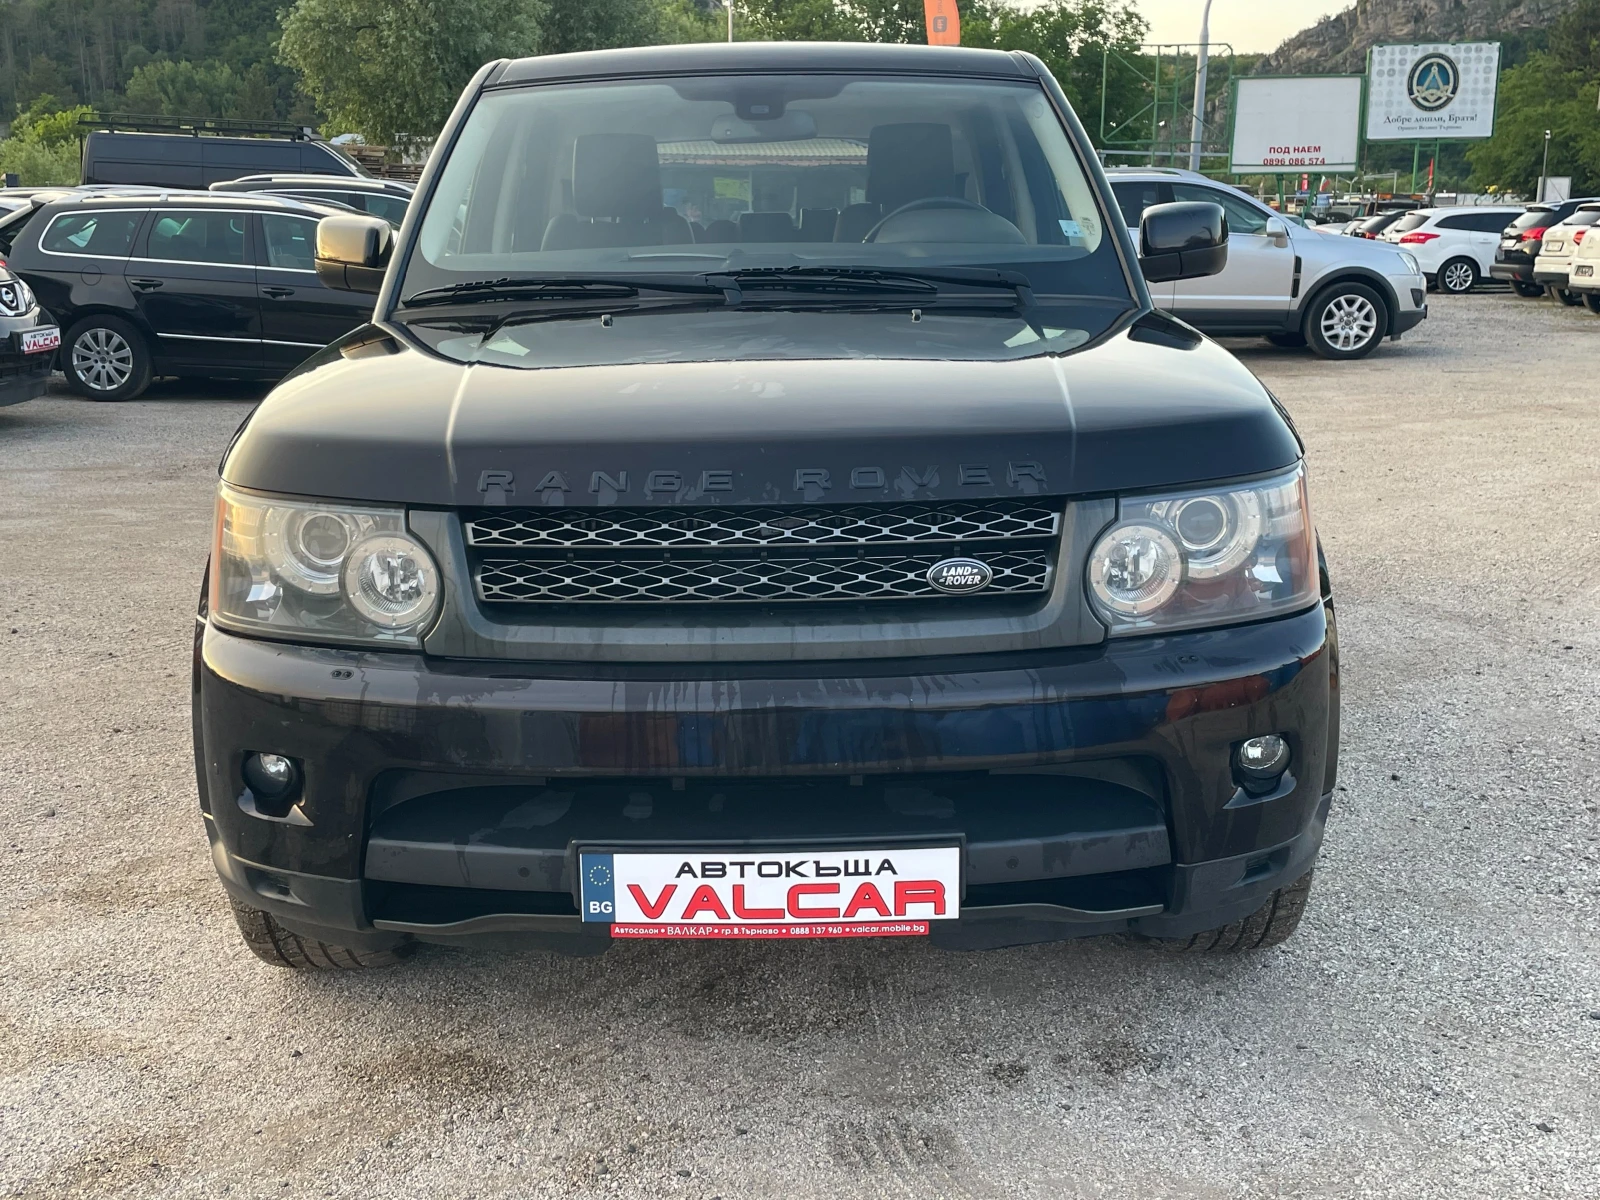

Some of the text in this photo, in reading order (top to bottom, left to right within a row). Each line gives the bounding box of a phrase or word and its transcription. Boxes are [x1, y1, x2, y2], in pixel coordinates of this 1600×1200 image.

[1383, 115, 1412, 125] Добре
[1448, 113, 1478, 124] Братя!
[1268, 145, 1321, 155] ПОД НАЕМ
[1262, 157, 1326, 166] 0896 086 574
[25, 336, 59, 349] VALCAR
[479, 460, 1048, 493] RANGE ROVER
[941, 566, 972, 577] LAND
[944, 575, 982, 586] ROVER
[674, 858, 899, 879] АВТОКЪЩА
[626, 879, 946, 920] VALCAR
[589, 901, 613, 914] BG
[614, 926, 659, 935] Автосалон
[667, 926, 713, 936] ВАЛКАР
[790, 927, 810, 935] 0888
[812, 926, 826, 935] 137
[828, 926, 843, 934] 960
[851, 924, 925, 933] valcar.mobile.bg
